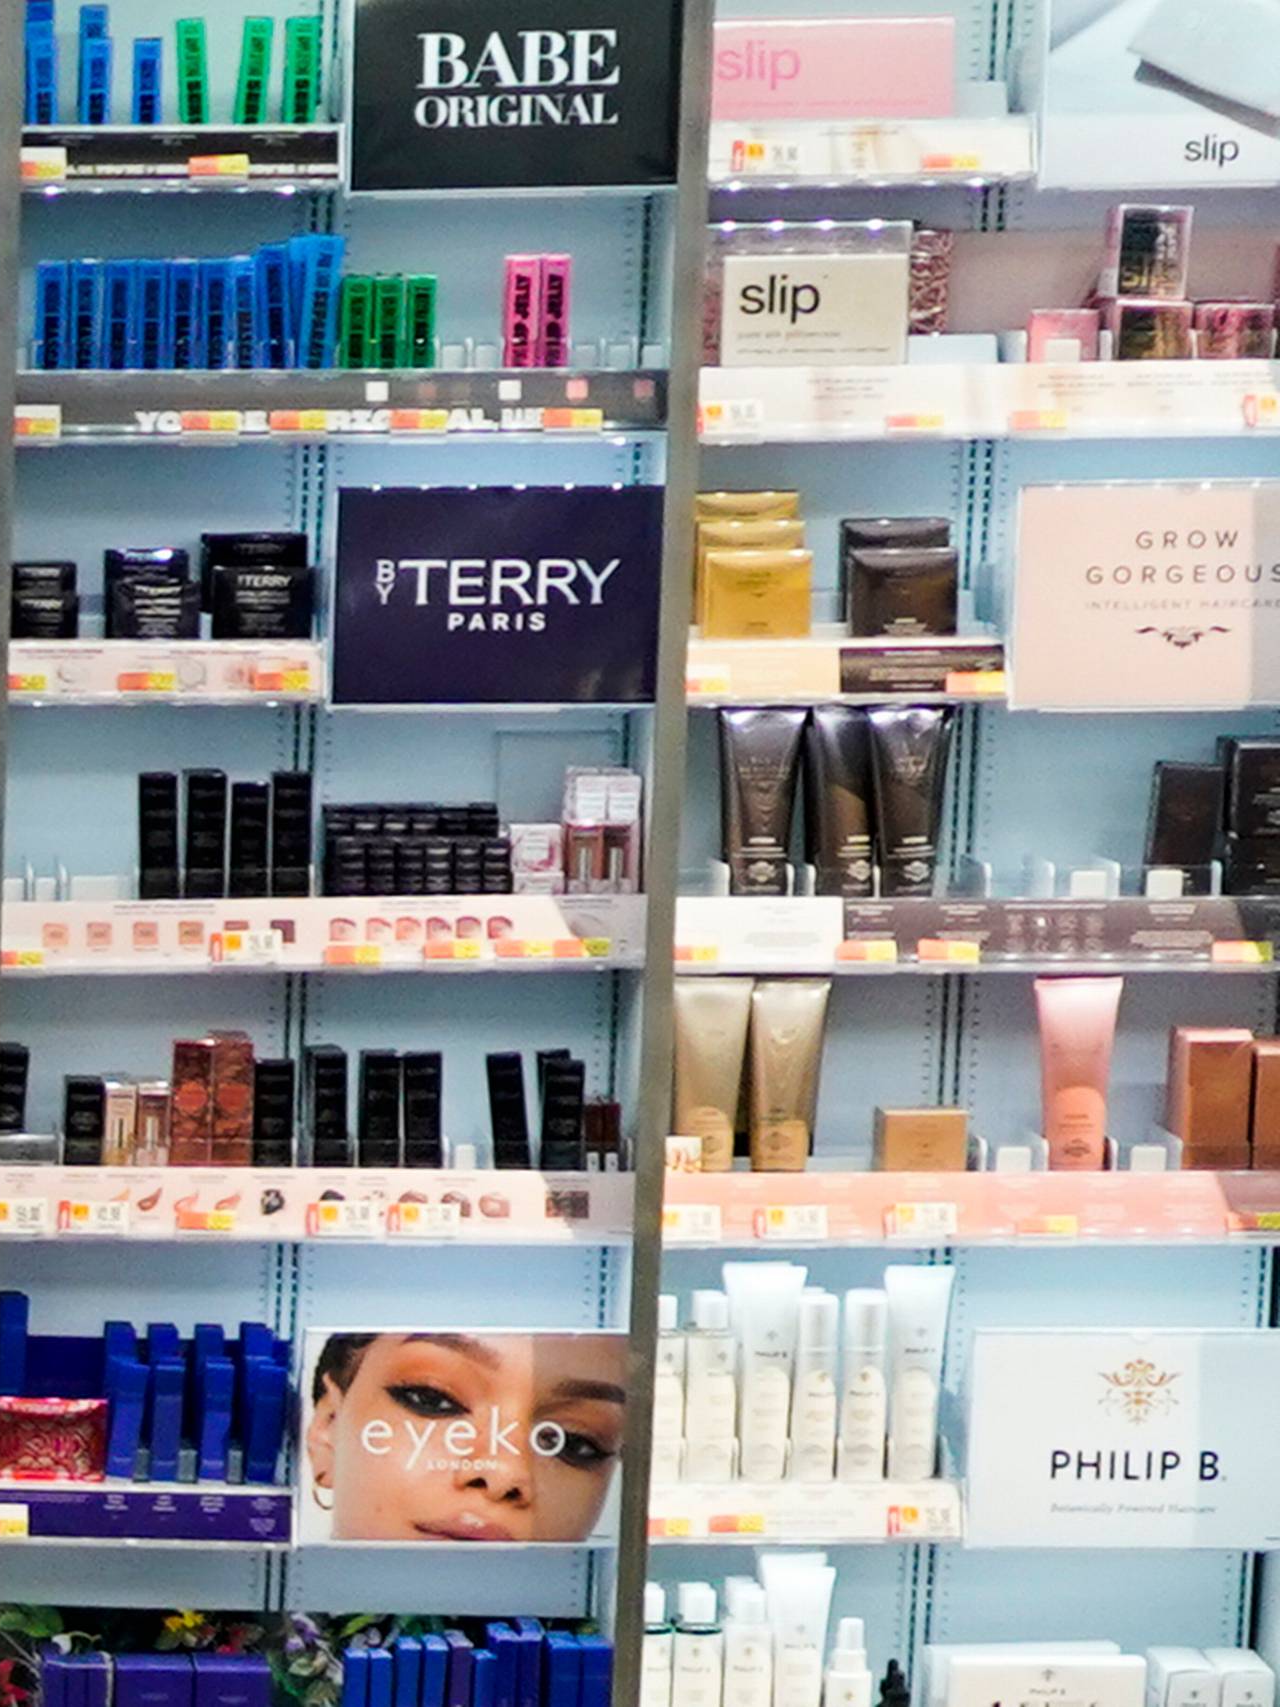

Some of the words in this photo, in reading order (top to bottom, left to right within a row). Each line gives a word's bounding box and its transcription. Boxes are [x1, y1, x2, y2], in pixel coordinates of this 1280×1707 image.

[417, 28, 620, 89] BABE
[716, 40, 802, 90] slip
[414, 93, 619, 128] ORIGINAL
[1184, 134, 1240, 168] slip
[739, 274, 821, 324] slip
[1136, 530, 1238, 550] GROW
[399, 559, 621, 605] TERRY
[1085, 564, 1280, 584] GORGEOUS
[447, 612, 546, 631] PARIS
[361, 1407, 566, 1473] eyeko
[427, 1459, 498, 1470] LONDON
[1051, 1450, 1180, 1480] PHILIP
